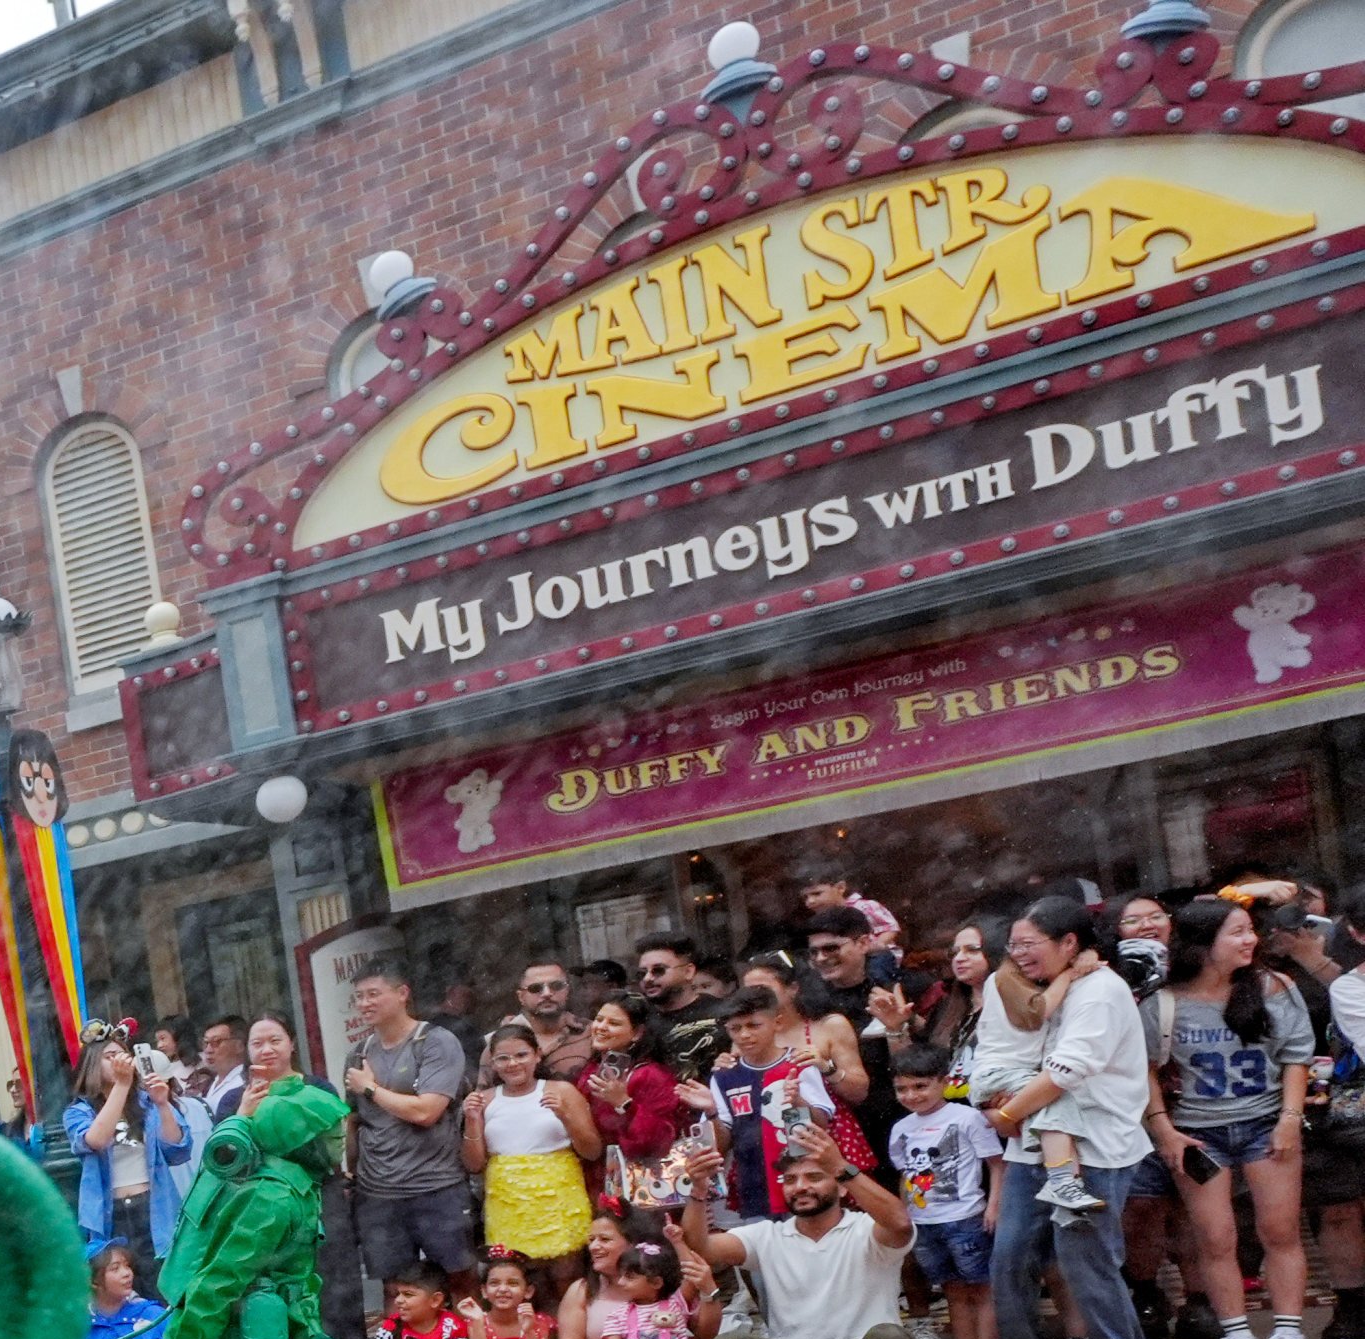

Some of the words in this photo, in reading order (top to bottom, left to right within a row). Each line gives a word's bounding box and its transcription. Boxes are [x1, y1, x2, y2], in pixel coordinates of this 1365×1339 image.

[380, 175, 1317, 504] CINEMA
[503, 223, 783, 384] MAIN
[378, 596, 489, 664] My
[497, 495, 859, 635] Journeys
[865, 458, 1016, 529] WITH
[1025, 363, 1324, 490] Duffy
[544, 741, 735, 814] DUFFY
[751, 712, 872, 766] AND
[892, 642, 1184, 732] FRIENDS
[710, 707, 760, 730] Begin
[763, 696, 808, 718] Your
[811, 687, 850, 705] Own
[853, 670, 925, 697] Journey
[928, 657, 968, 678] with
[807, 757, 878, 780] FUJIFILM
[730, 1092, 754, 1117] M
[1189, 1049, 1268, 1098] 33
